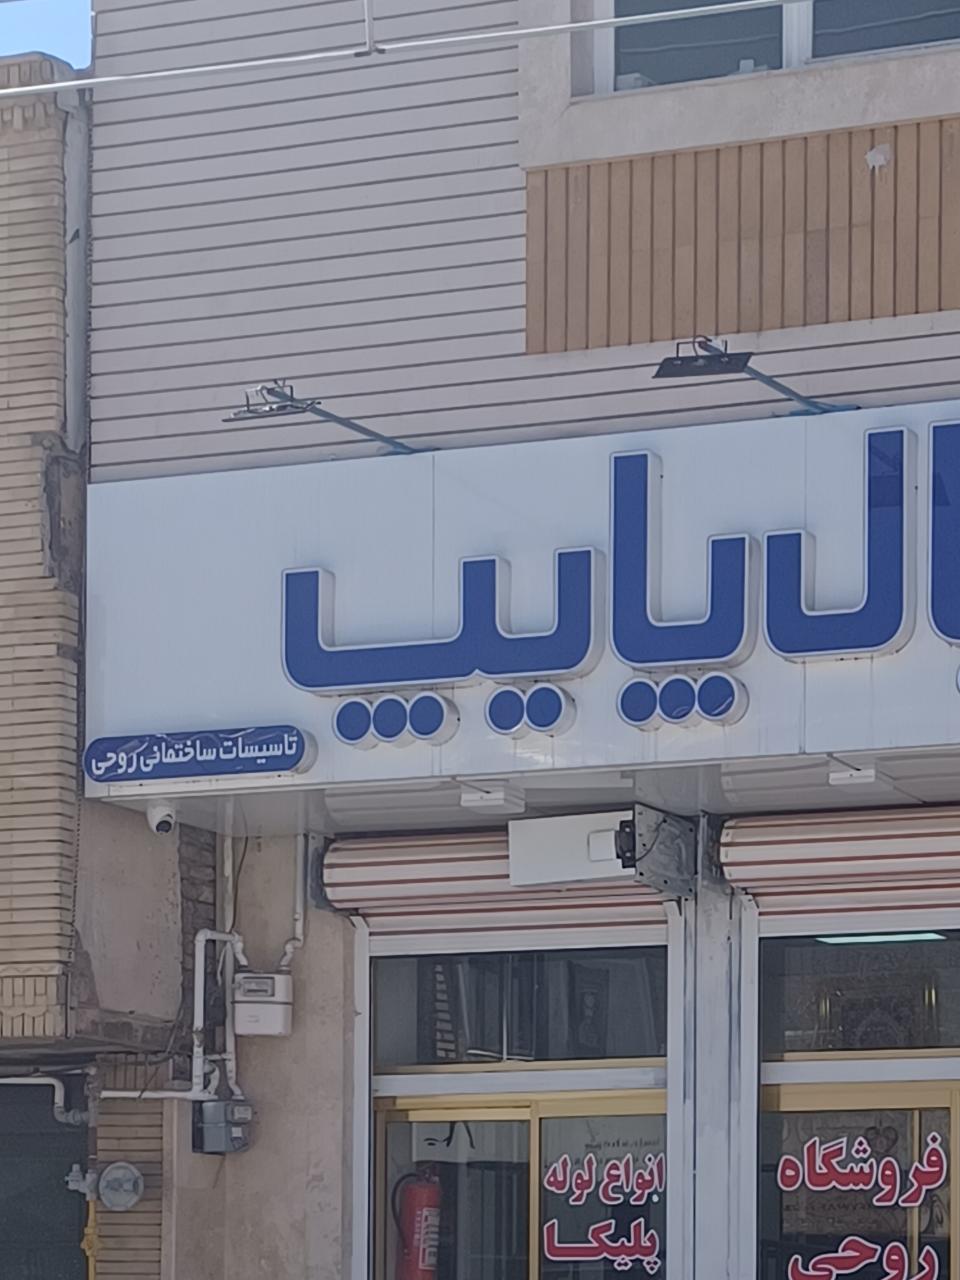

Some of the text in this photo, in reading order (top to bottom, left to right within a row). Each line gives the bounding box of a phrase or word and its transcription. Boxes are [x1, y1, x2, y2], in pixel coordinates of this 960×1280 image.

[282, 449, 758, 747] پایپ
[91, 750, 138, 776] روحی
[140, 740, 217, 773] ساختمانی
[543, 1153, 666, 1205] انواع لوله
[777, 1131, 948, 1206] فروشگاه
[543, 1217, 660, 1275] پلیکا
